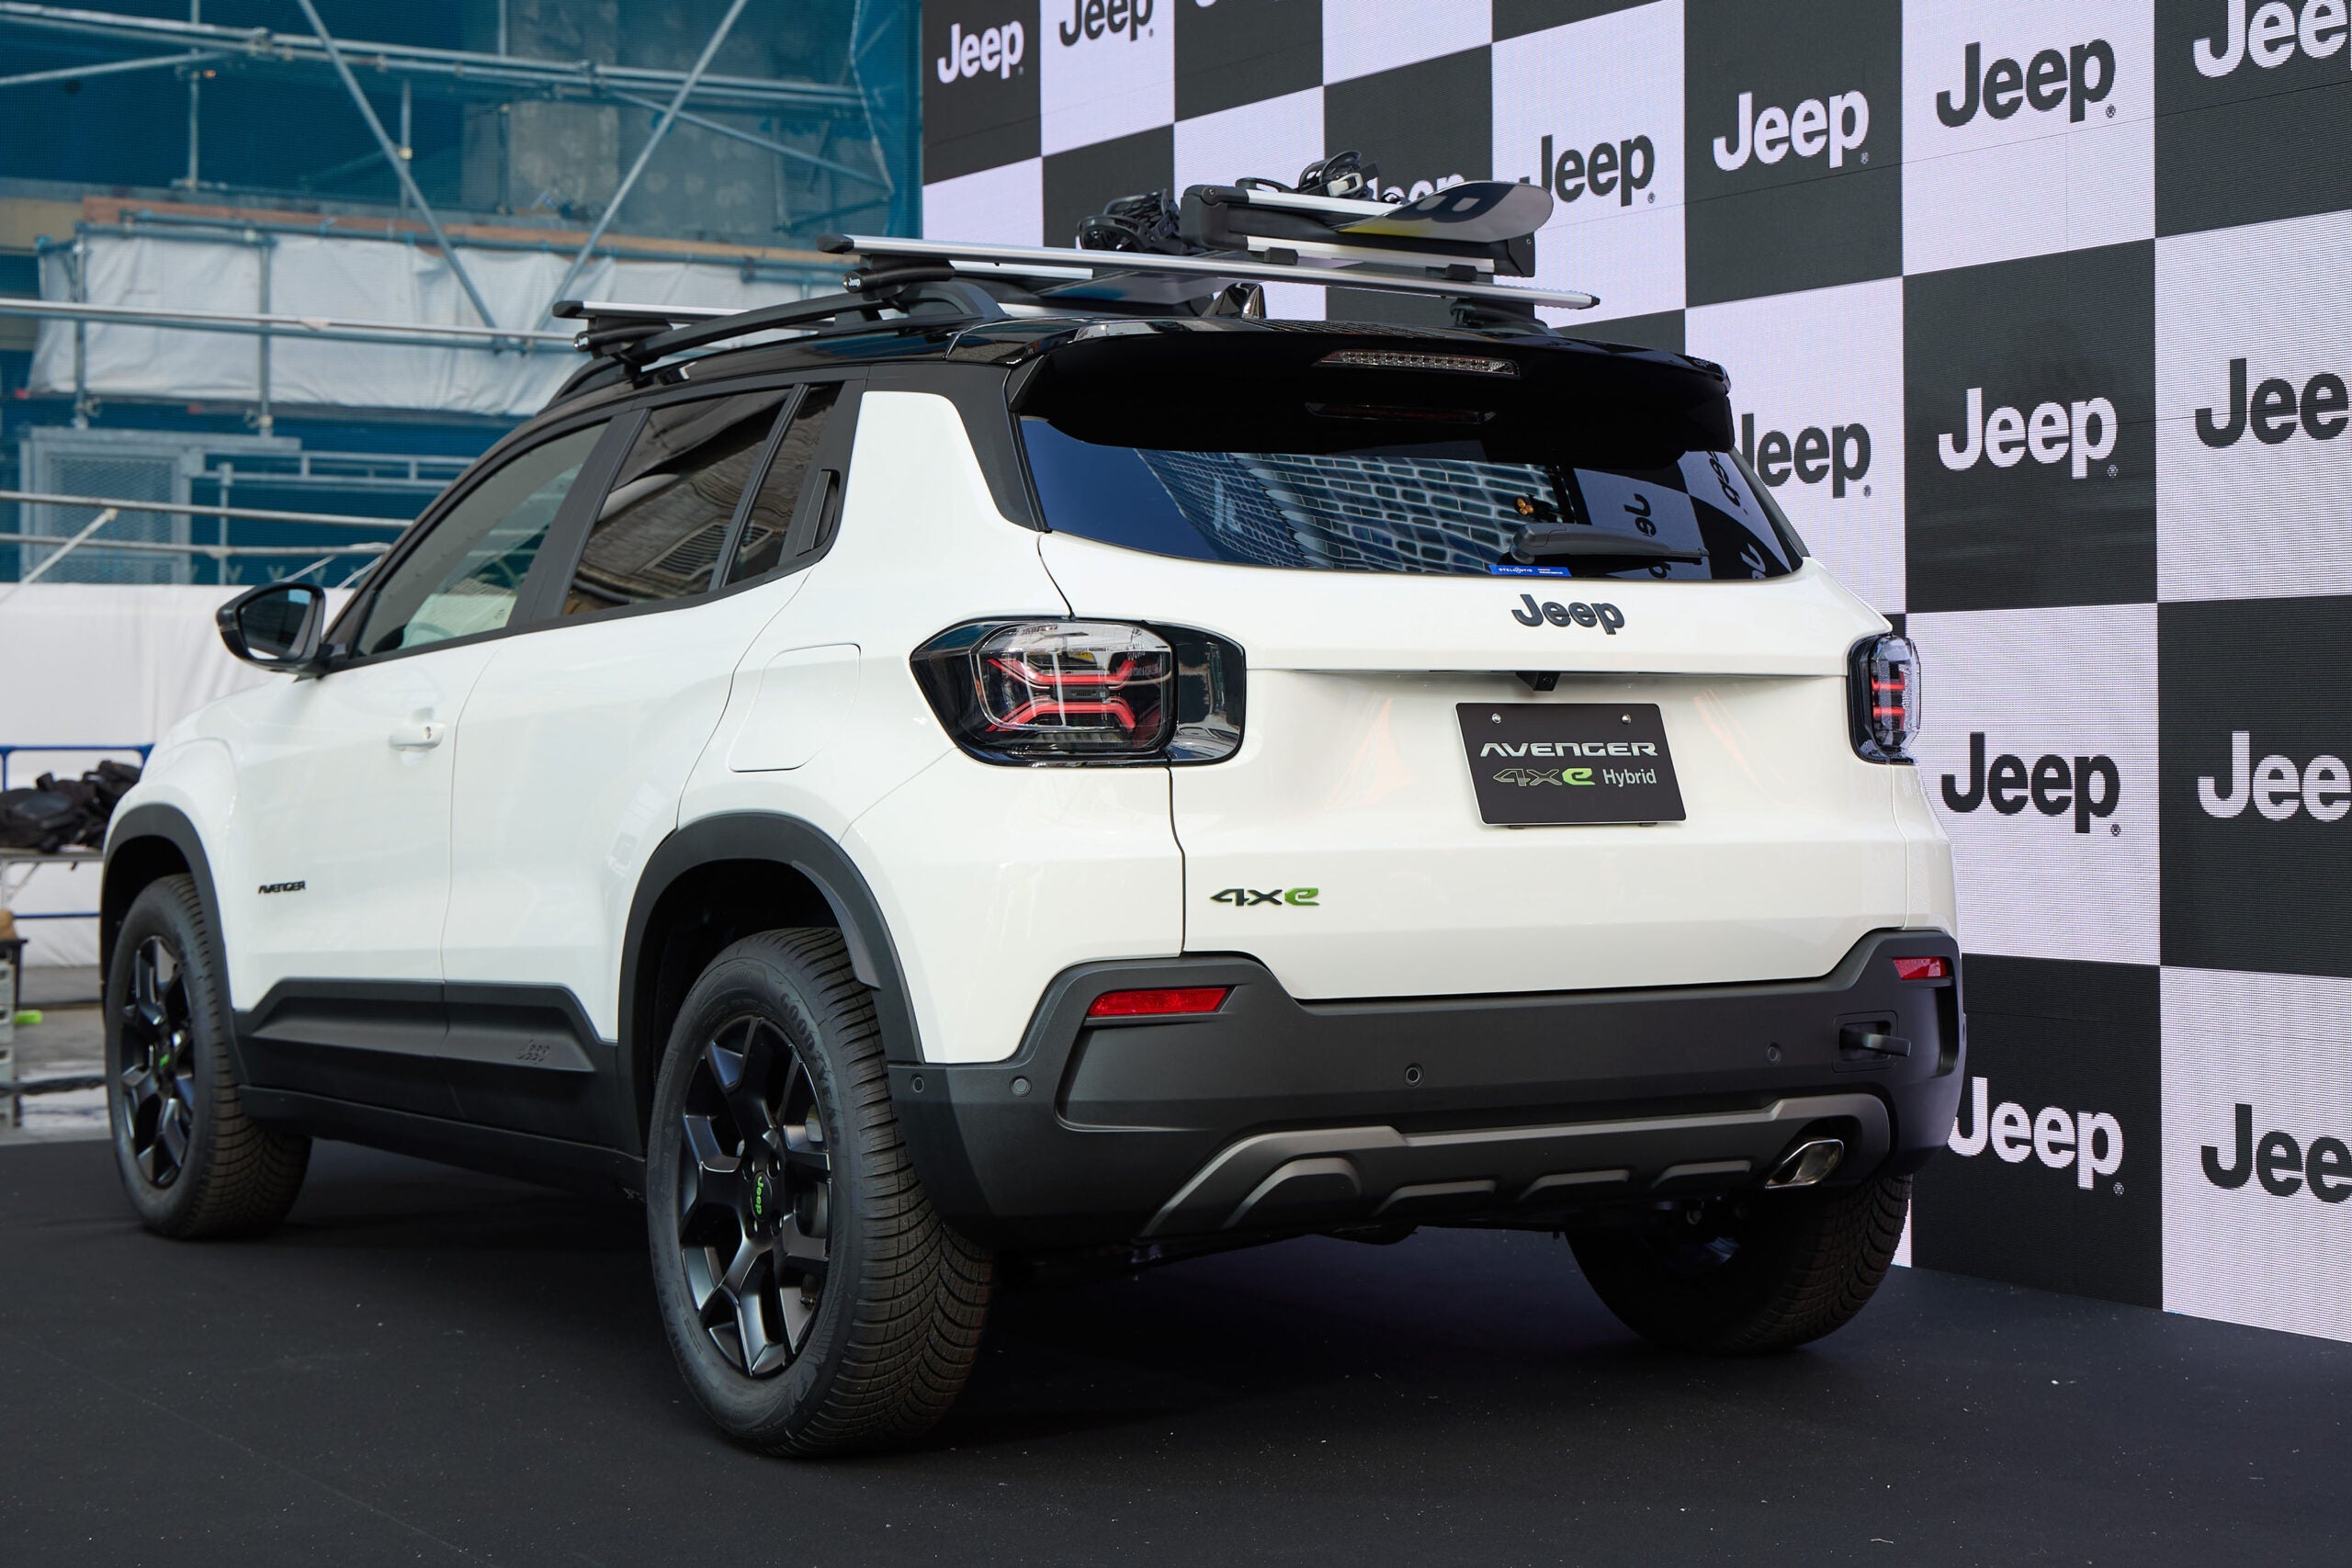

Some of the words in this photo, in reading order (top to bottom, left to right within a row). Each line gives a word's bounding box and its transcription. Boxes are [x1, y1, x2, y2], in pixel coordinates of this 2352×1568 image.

[2193, 0, 2352, 77] Jee
[2195, 357, 2349, 448] Jee
[1511, 594, 1624, 635] Jeep
[1480, 742, 1657, 757] AVENGER
[1602, 769, 1657, 787] Hybrid
[2198, 730, 2352, 822] Jee
[258, 880, 305, 894] AVENGER
[2200, 1103, 2352, 1203] Jee
